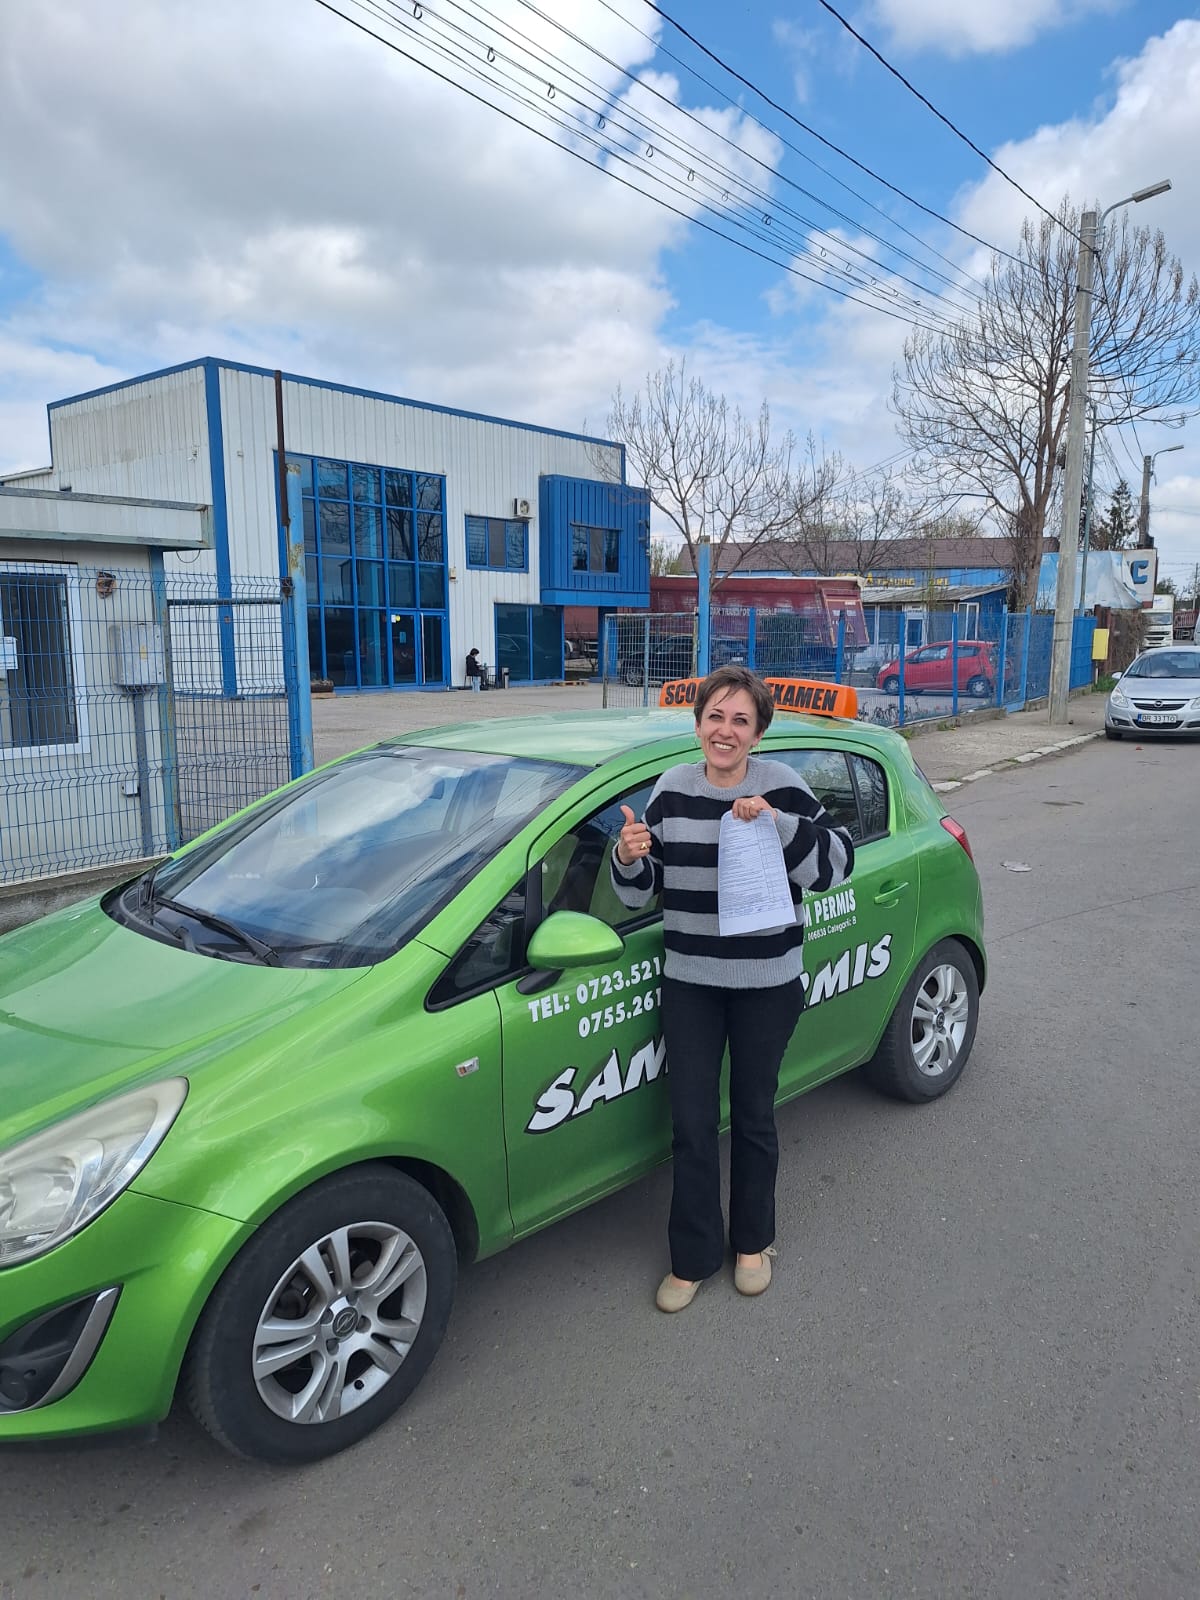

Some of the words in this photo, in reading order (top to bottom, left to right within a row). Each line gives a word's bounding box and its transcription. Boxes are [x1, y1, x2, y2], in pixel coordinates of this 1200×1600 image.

[1127, 560, 1149, 585] C
[814, 888, 856, 924] PERMIS
[851, 915, 857, 925] B
[528, 993, 571, 1022] TEL:
[576, 957, 661, 1004] 0723.521
[578, 987, 662, 1037] 0755.261
